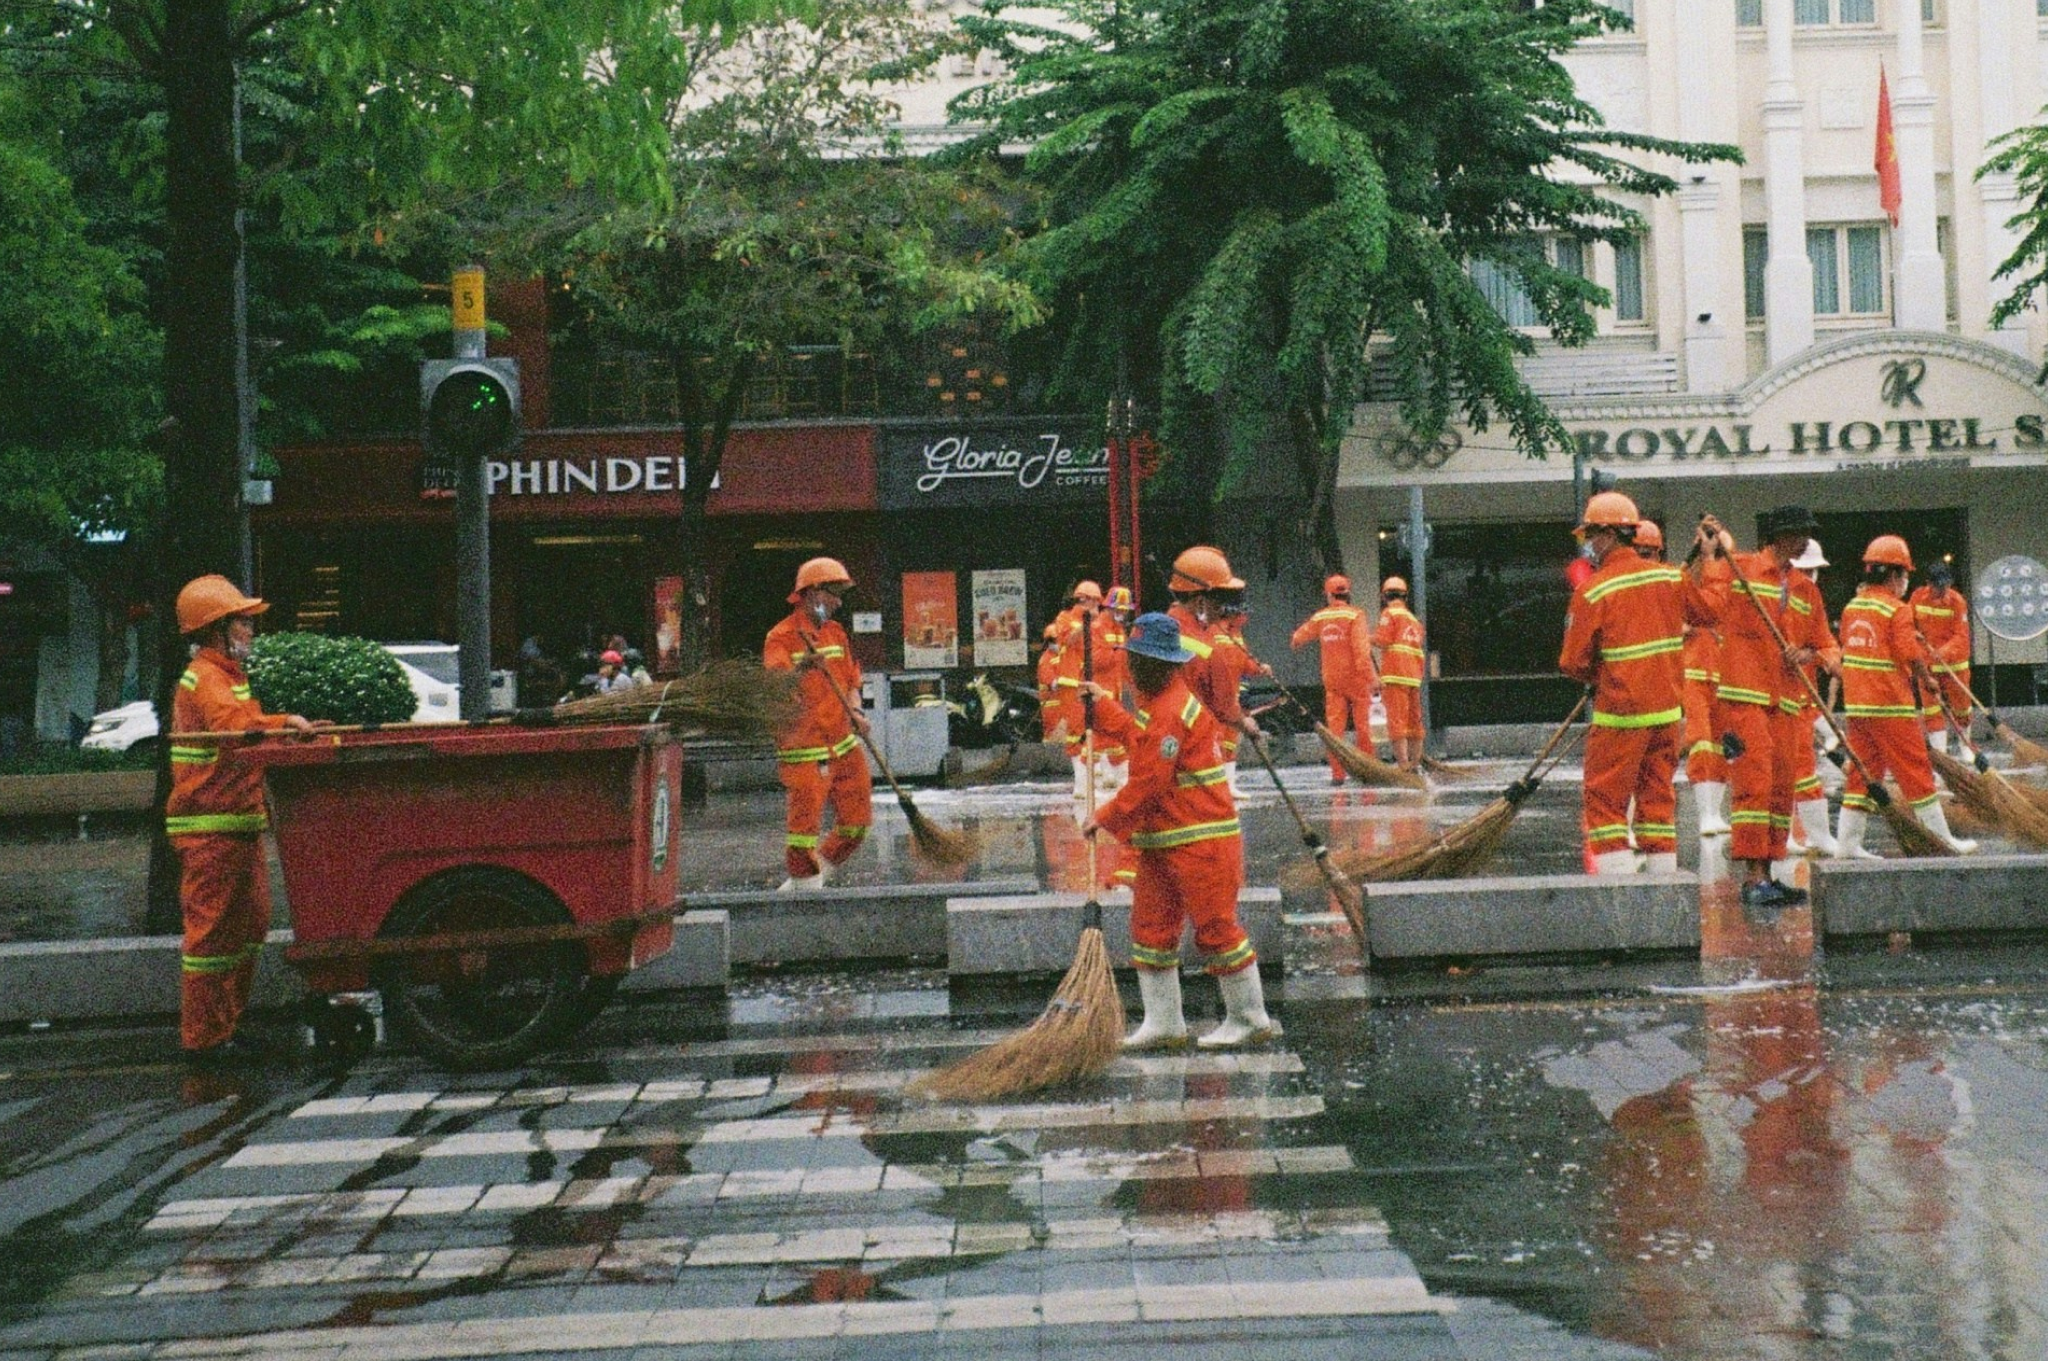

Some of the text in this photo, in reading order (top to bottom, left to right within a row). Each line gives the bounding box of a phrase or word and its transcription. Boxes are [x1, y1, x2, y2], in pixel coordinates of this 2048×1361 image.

[462, 291, 475, 310] 5
[1574, 425, 1770, 461] ROYAL
[1789, 417, 1997, 455] HOTEL
[916, 436, 1021, 492] Gloria
